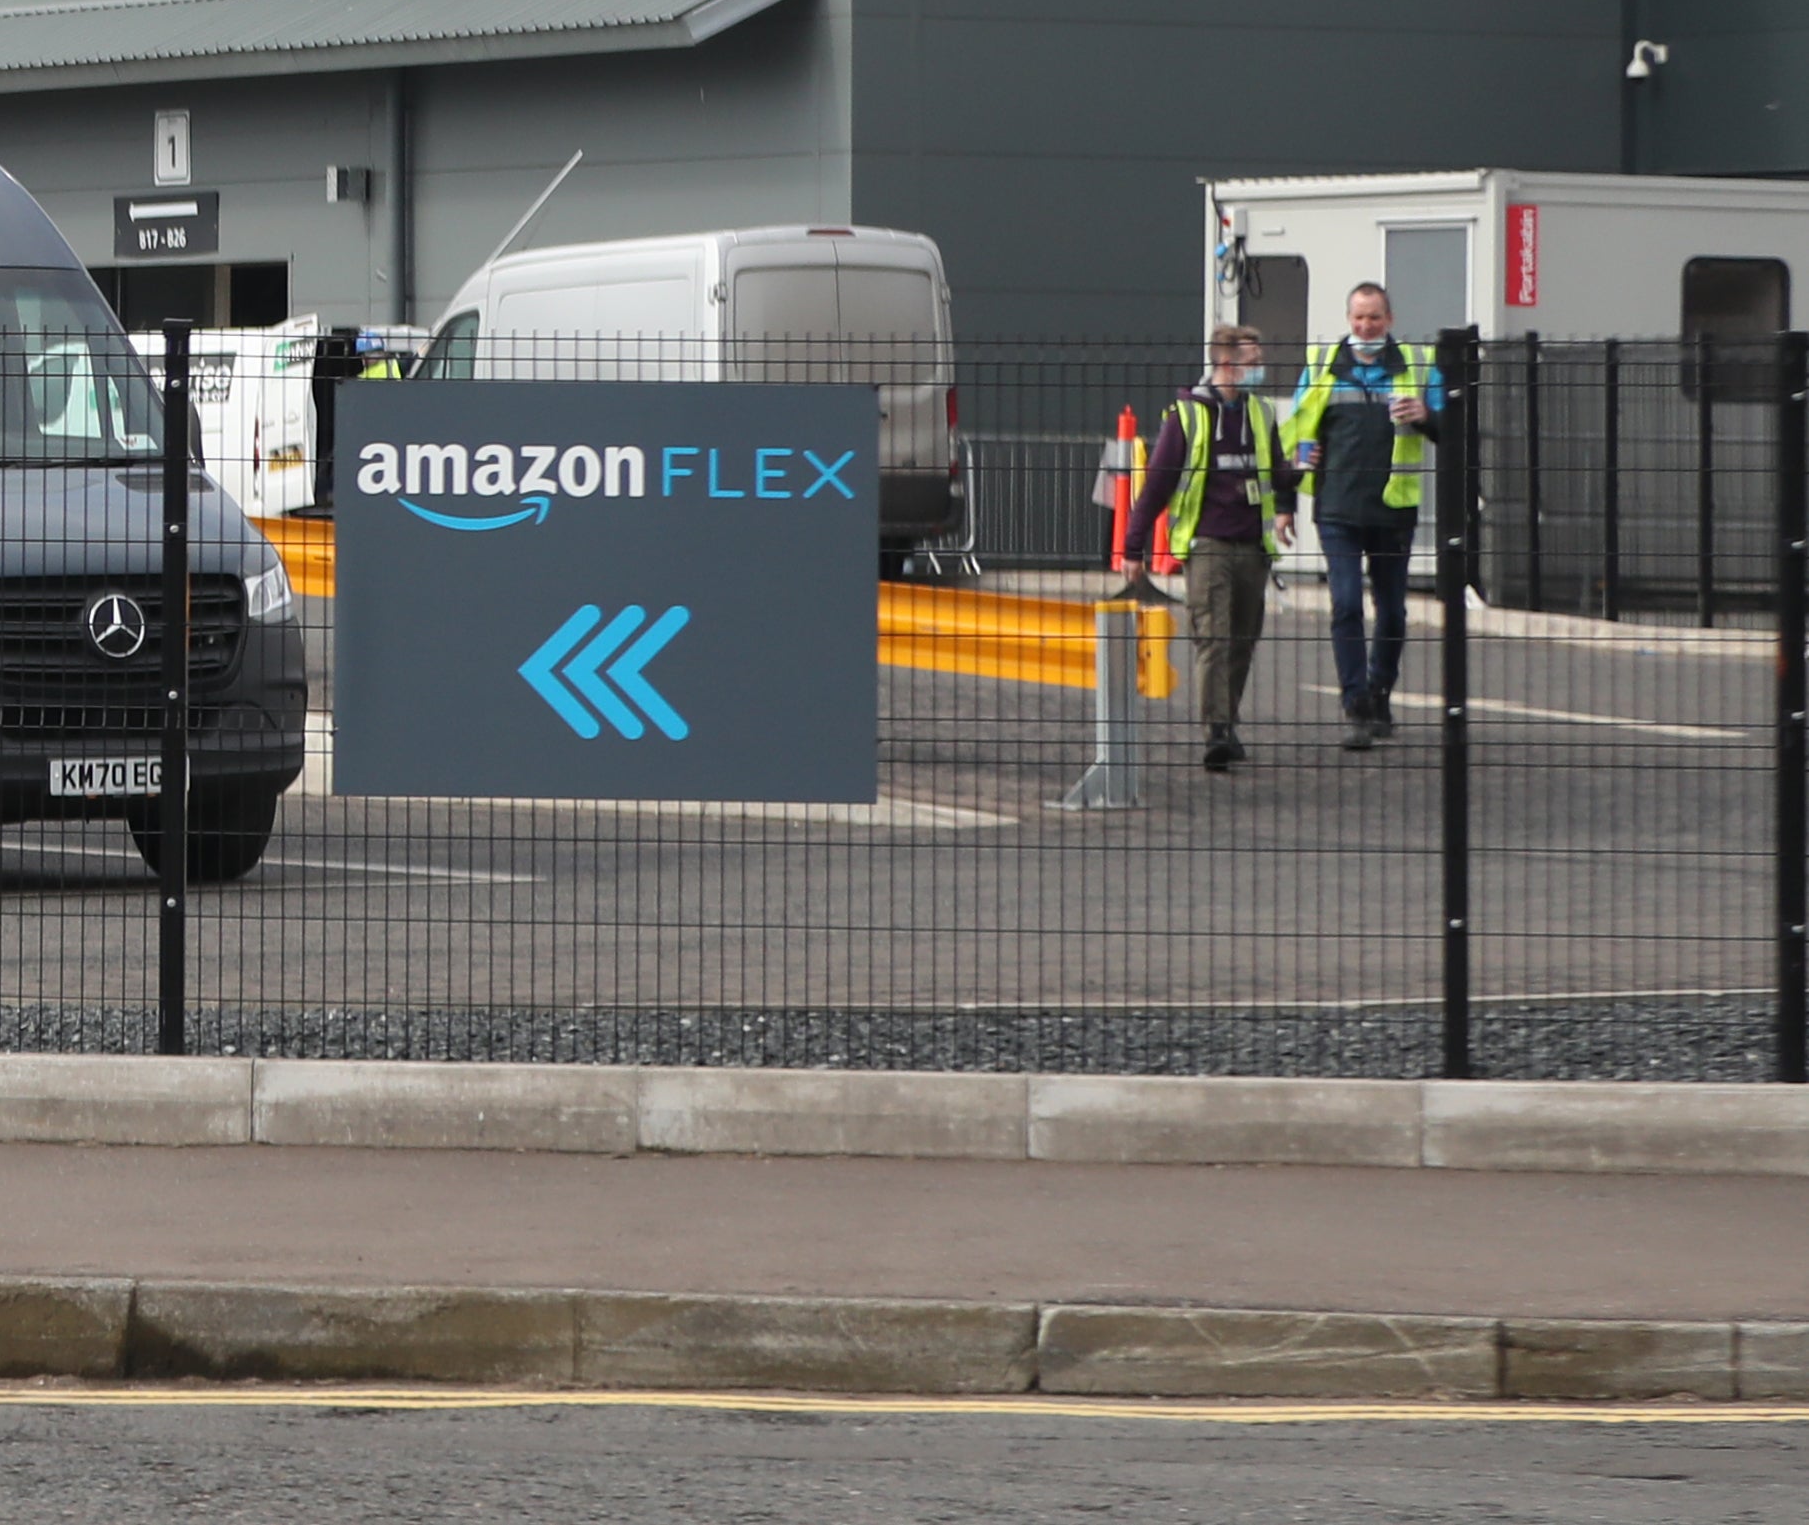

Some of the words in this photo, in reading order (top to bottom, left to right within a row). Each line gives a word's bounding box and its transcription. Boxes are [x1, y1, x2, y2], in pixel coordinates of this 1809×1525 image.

[167, 134, 176, 169] 1
[1518, 208, 1534, 304] Portakabin
[356, 441, 645, 498] amazon
[661, 446, 855, 500] FLEX
[62, 761, 126, 790] KM70
[133, 760, 161, 786] EG
